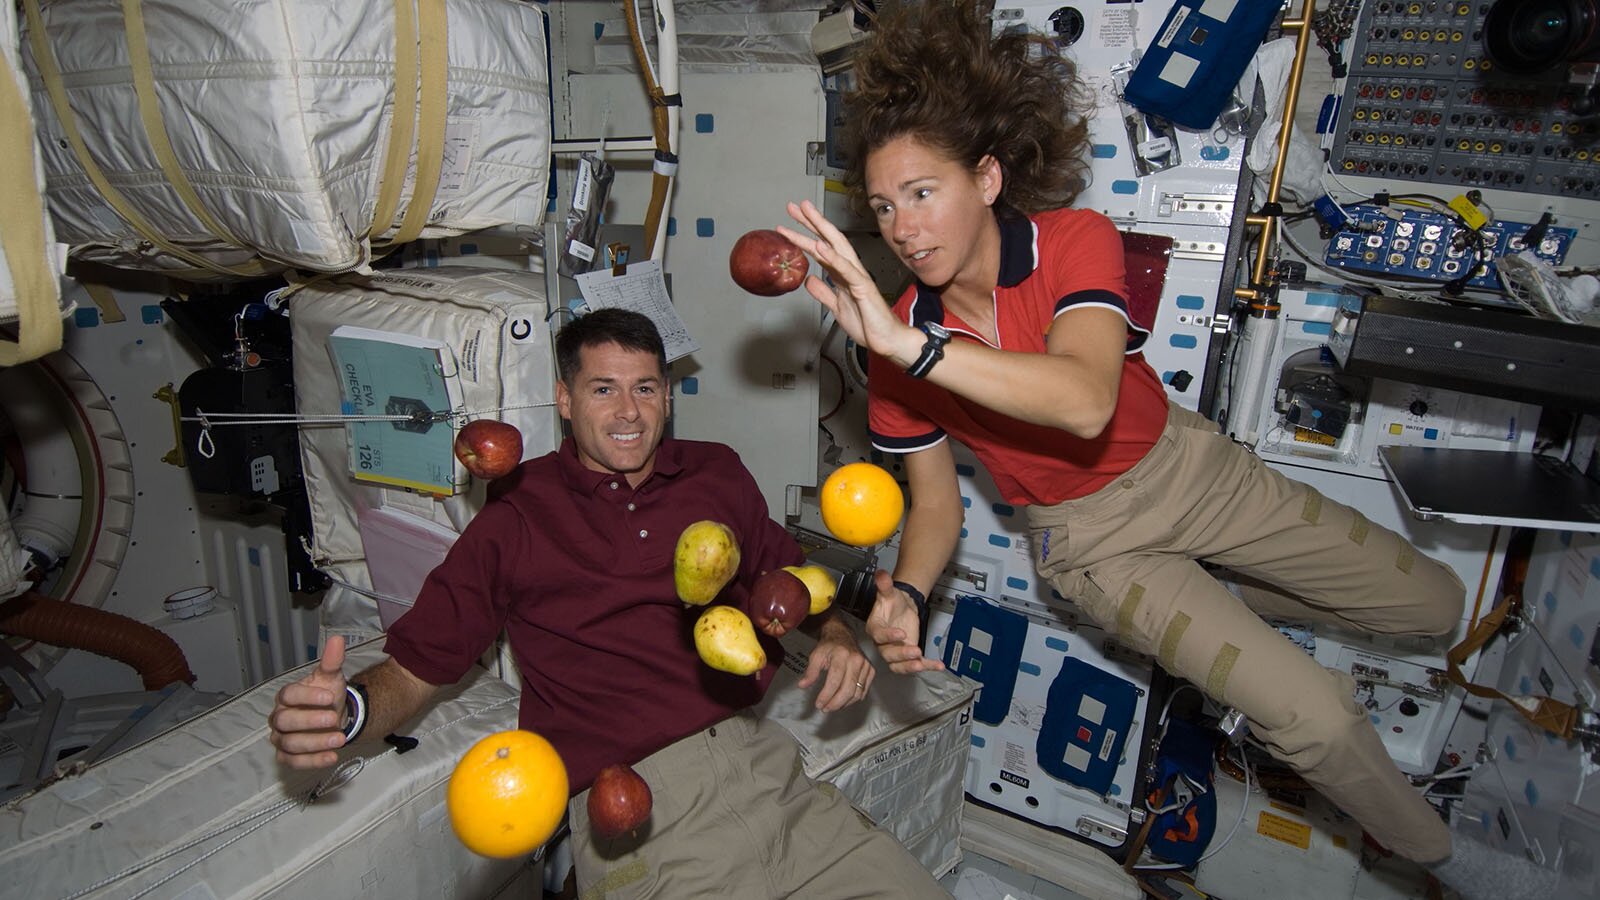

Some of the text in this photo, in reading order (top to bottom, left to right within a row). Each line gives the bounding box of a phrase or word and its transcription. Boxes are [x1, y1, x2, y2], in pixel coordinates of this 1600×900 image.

[578, 183, 587, 206] Drinking
[511, 319, 532, 341] C
[345, 363, 367, 427] CHECKLIT
[362, 384, 375, 407] EVA
[359, 444, 373, 471] 126
[373, 449, 381, 468] STS
[873, 752, 889, 764] NOT
[889, 745, 902, 757] FOR
[1002, 772, 1028, 788] ML60M
